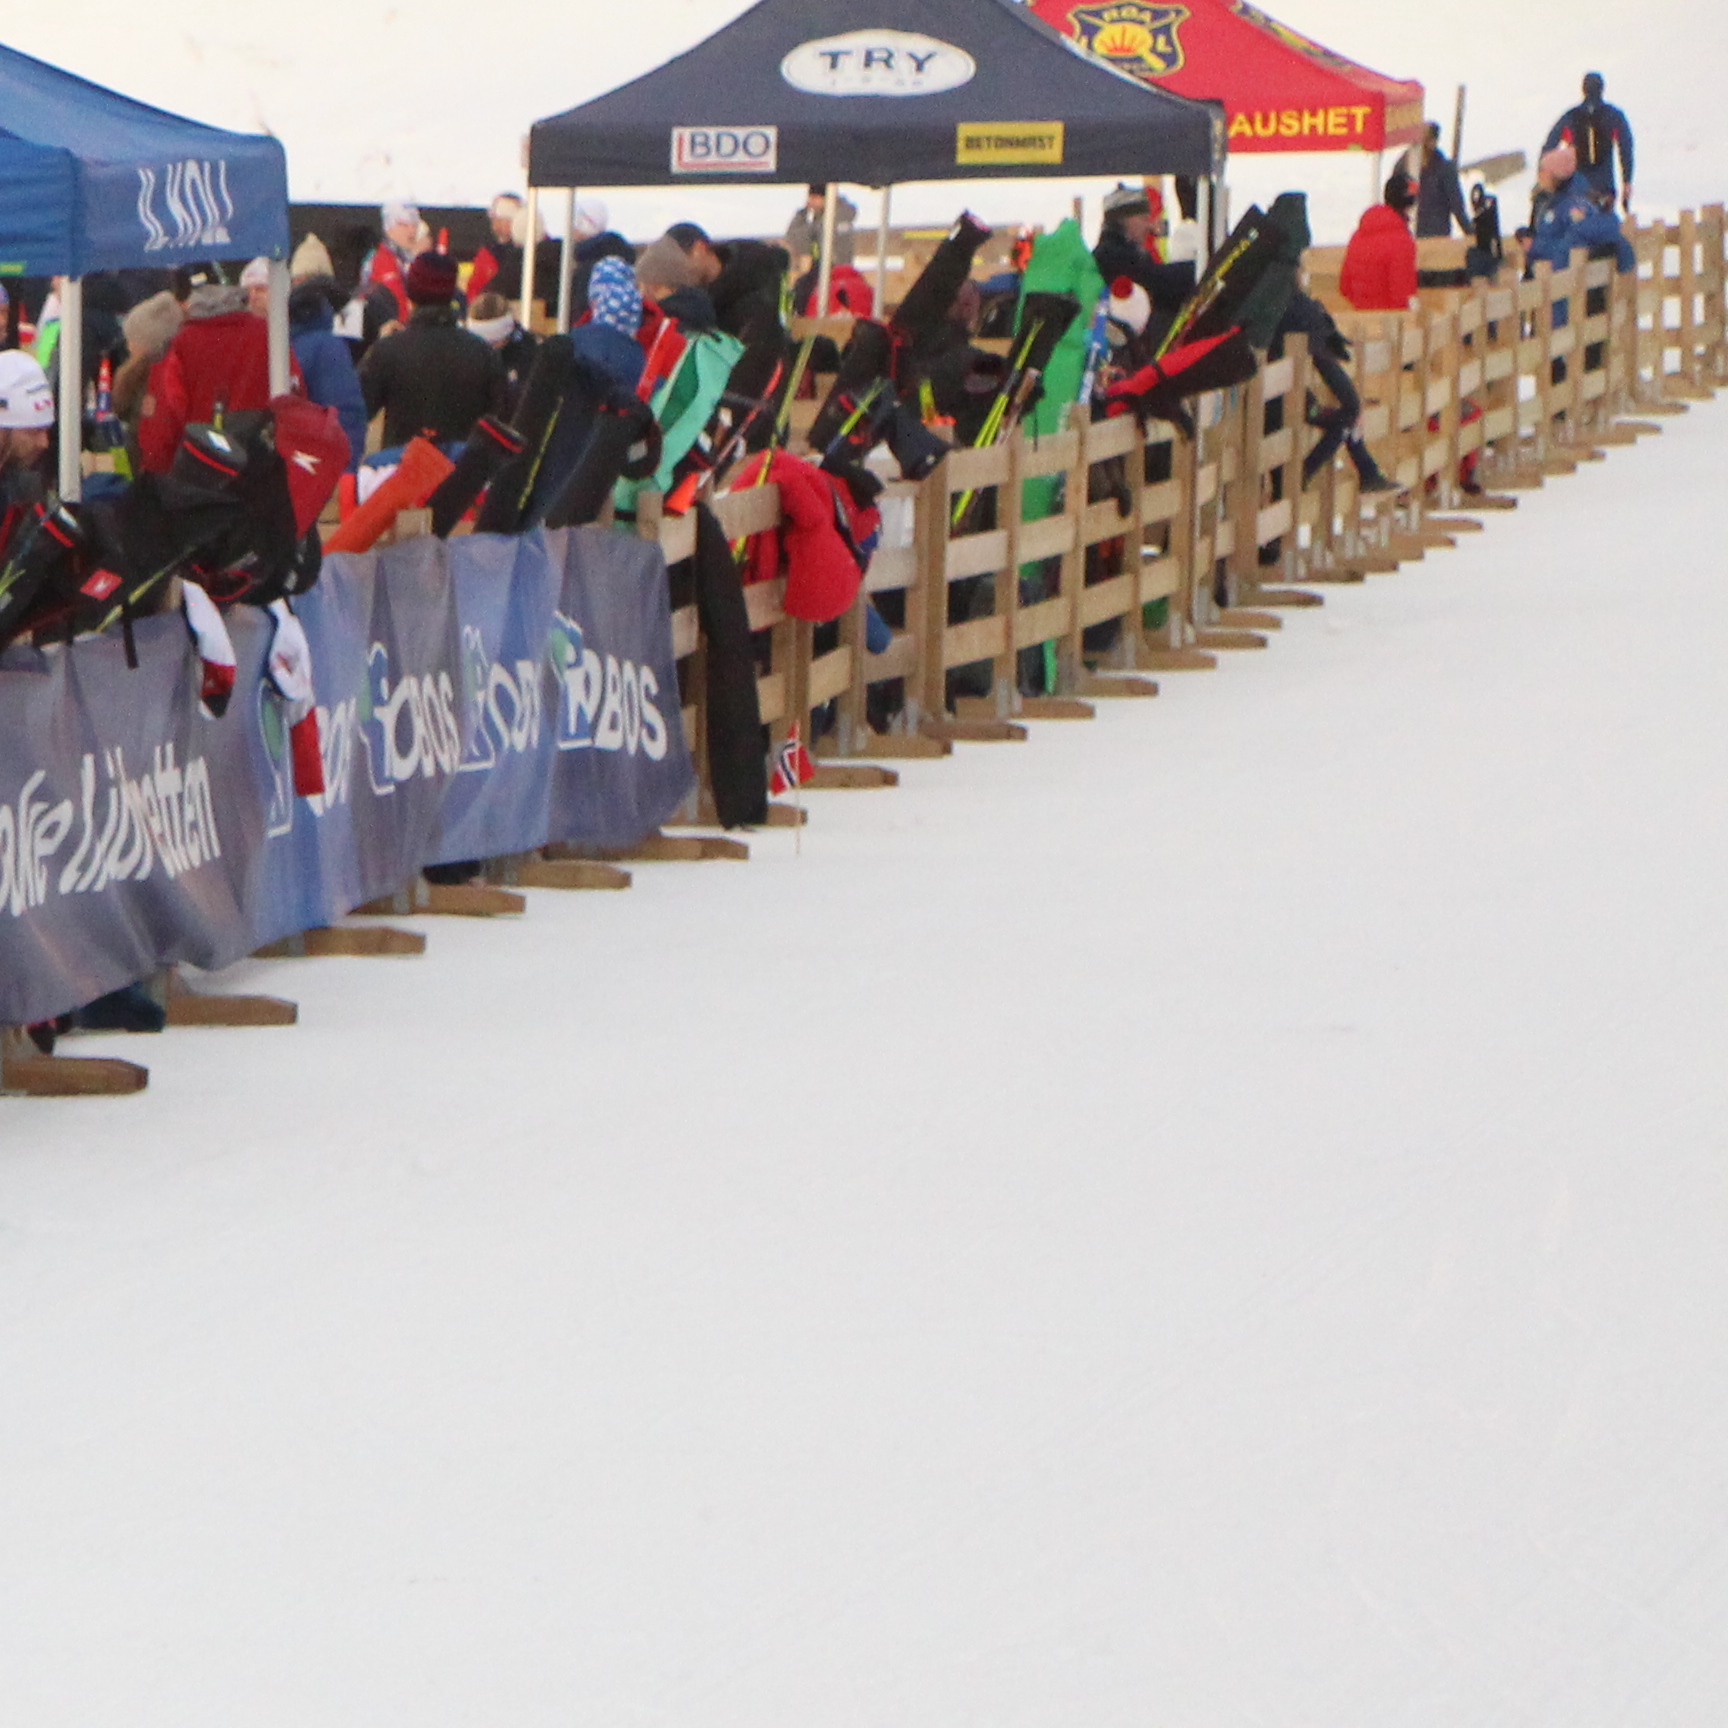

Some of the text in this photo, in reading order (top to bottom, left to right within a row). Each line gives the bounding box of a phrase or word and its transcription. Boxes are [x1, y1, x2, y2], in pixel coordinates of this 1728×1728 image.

[819, 47, 940, 74] TRY
[1230, 106, 1372, 138] AUSHET
[690, 131, 771, 158] BDO
